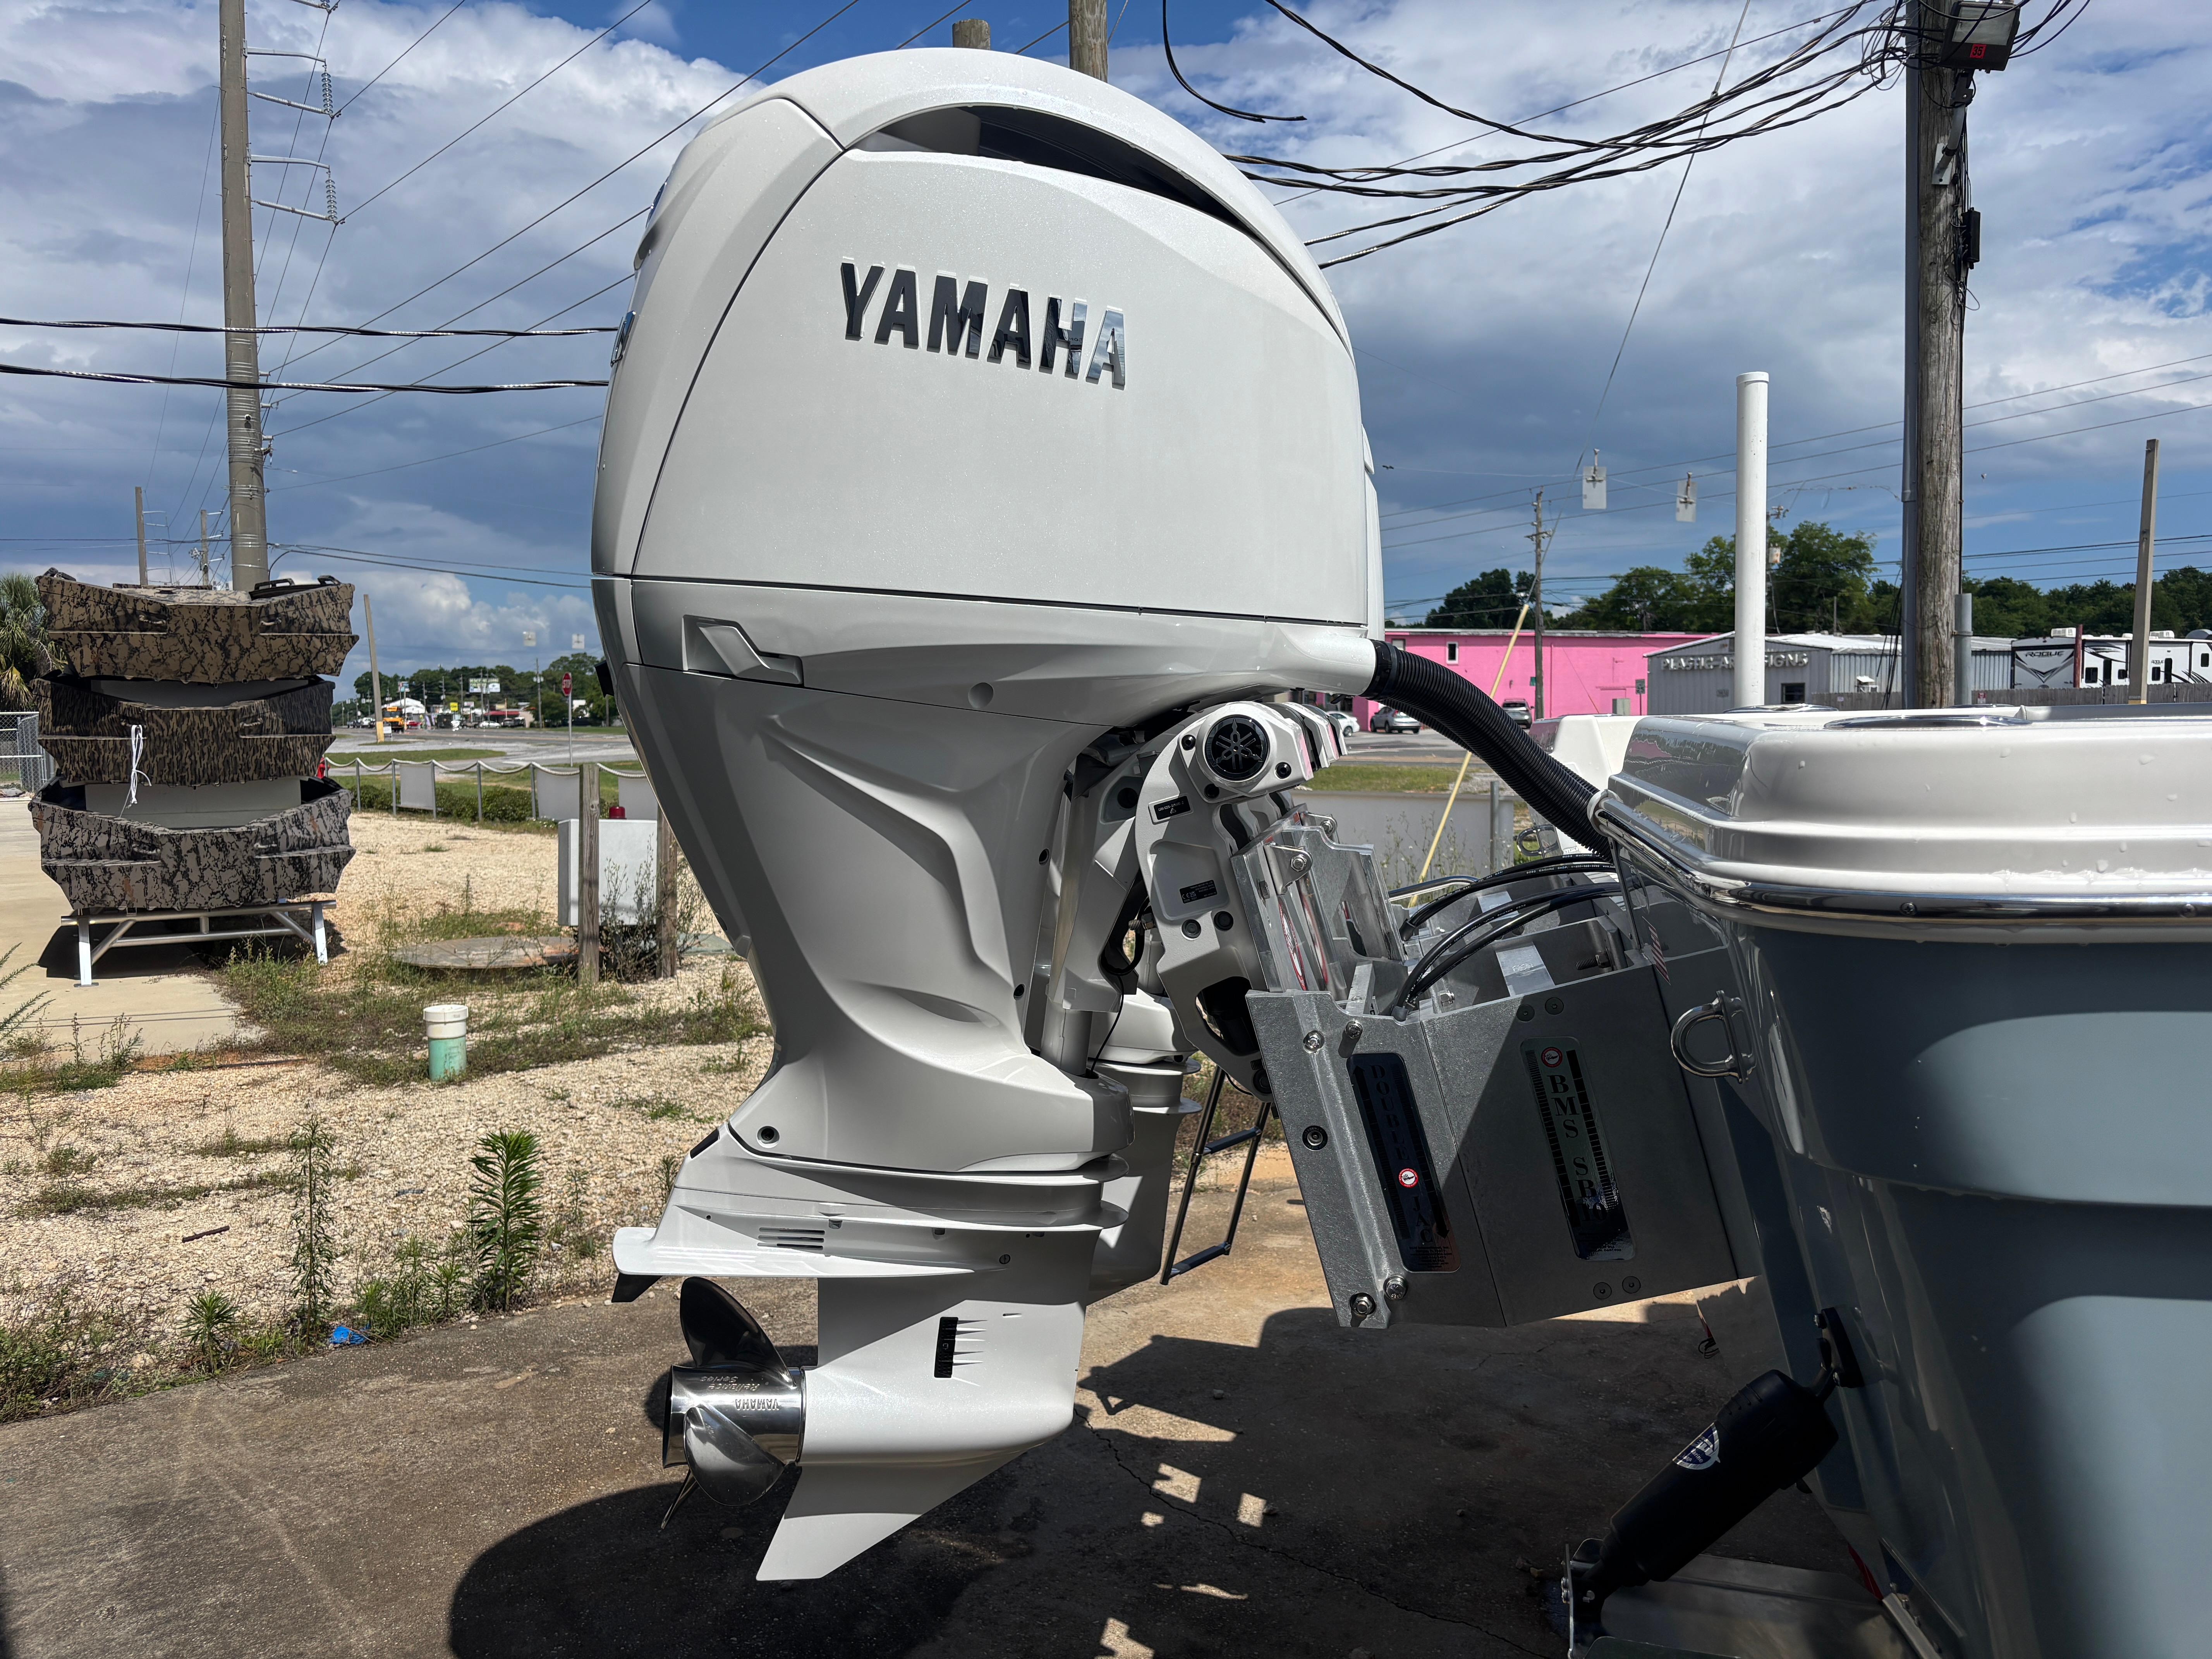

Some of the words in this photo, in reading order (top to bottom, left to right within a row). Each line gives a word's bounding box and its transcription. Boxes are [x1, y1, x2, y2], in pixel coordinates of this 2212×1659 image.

[1972, 46, 1983, 56] 35
[840, 259, 1126, 390] YAMAHA
[1661, 656, 1735, 670] PLASTIC-AR
[1371, 1065, 1409, 1160] DOUBLE
[1547, 1075, 1580, 1139] BMS
[1413, 1196, 1433, 1243] JAC
[708, 1382, 760, 1391] Reliance
[735, 1398, 780, 1411] YAMAHA
